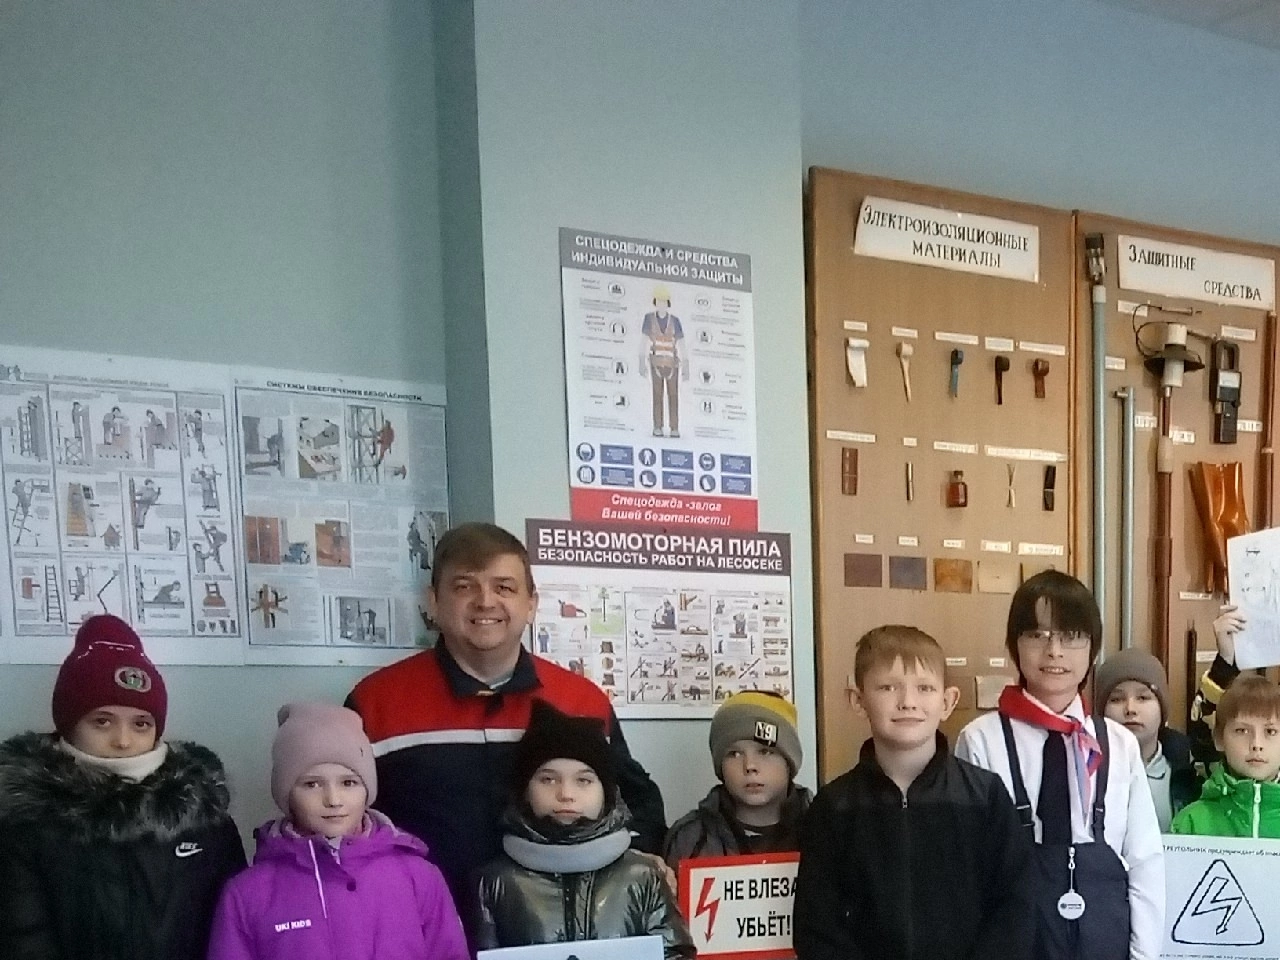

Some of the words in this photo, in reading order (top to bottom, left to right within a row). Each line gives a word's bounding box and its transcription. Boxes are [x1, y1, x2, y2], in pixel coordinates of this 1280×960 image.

[862, 204, 1029, 252] ЭЛЕКТРОИЗОЛЯЦИОННЫЕ
[575, 234, 662, 258] СПЕЦОДЕЖДА
[665, 250, 674, 259] И
[677, 251, 738, 268] СРЕДСТВА
[912, 239, 1001, 268] МАТЕРИАЛЫ
[571, 251, 688, 277] ИНДИВИДУАЛЬНОЙ
[691, 268, 743, 286] ЗАЩИТЫ
[1203, 279, 1262, 301] СРЕДСТВА
[612, 494, 683, 509] Спецодежда
[602, 507, 642, 520] Вашей
[645, 510, 731, 526] безопасности!
[539, 528, 723, 555] БЕНЗОМОТОРНАЯ
[728, 538, 782, 558] ПИЛА
[538, 548, 648, 565] БЕЗОПАСНОСТЬ
[652, 554, 693, 567] РАБОТ
[697, 556, 715, 568] НА
[717, 557, 783, 571] ЛЕСОСЕКЕ
[724, 879, 744, 901] НЕ
[736, 910, 791, 939] УБЬЁТ!
